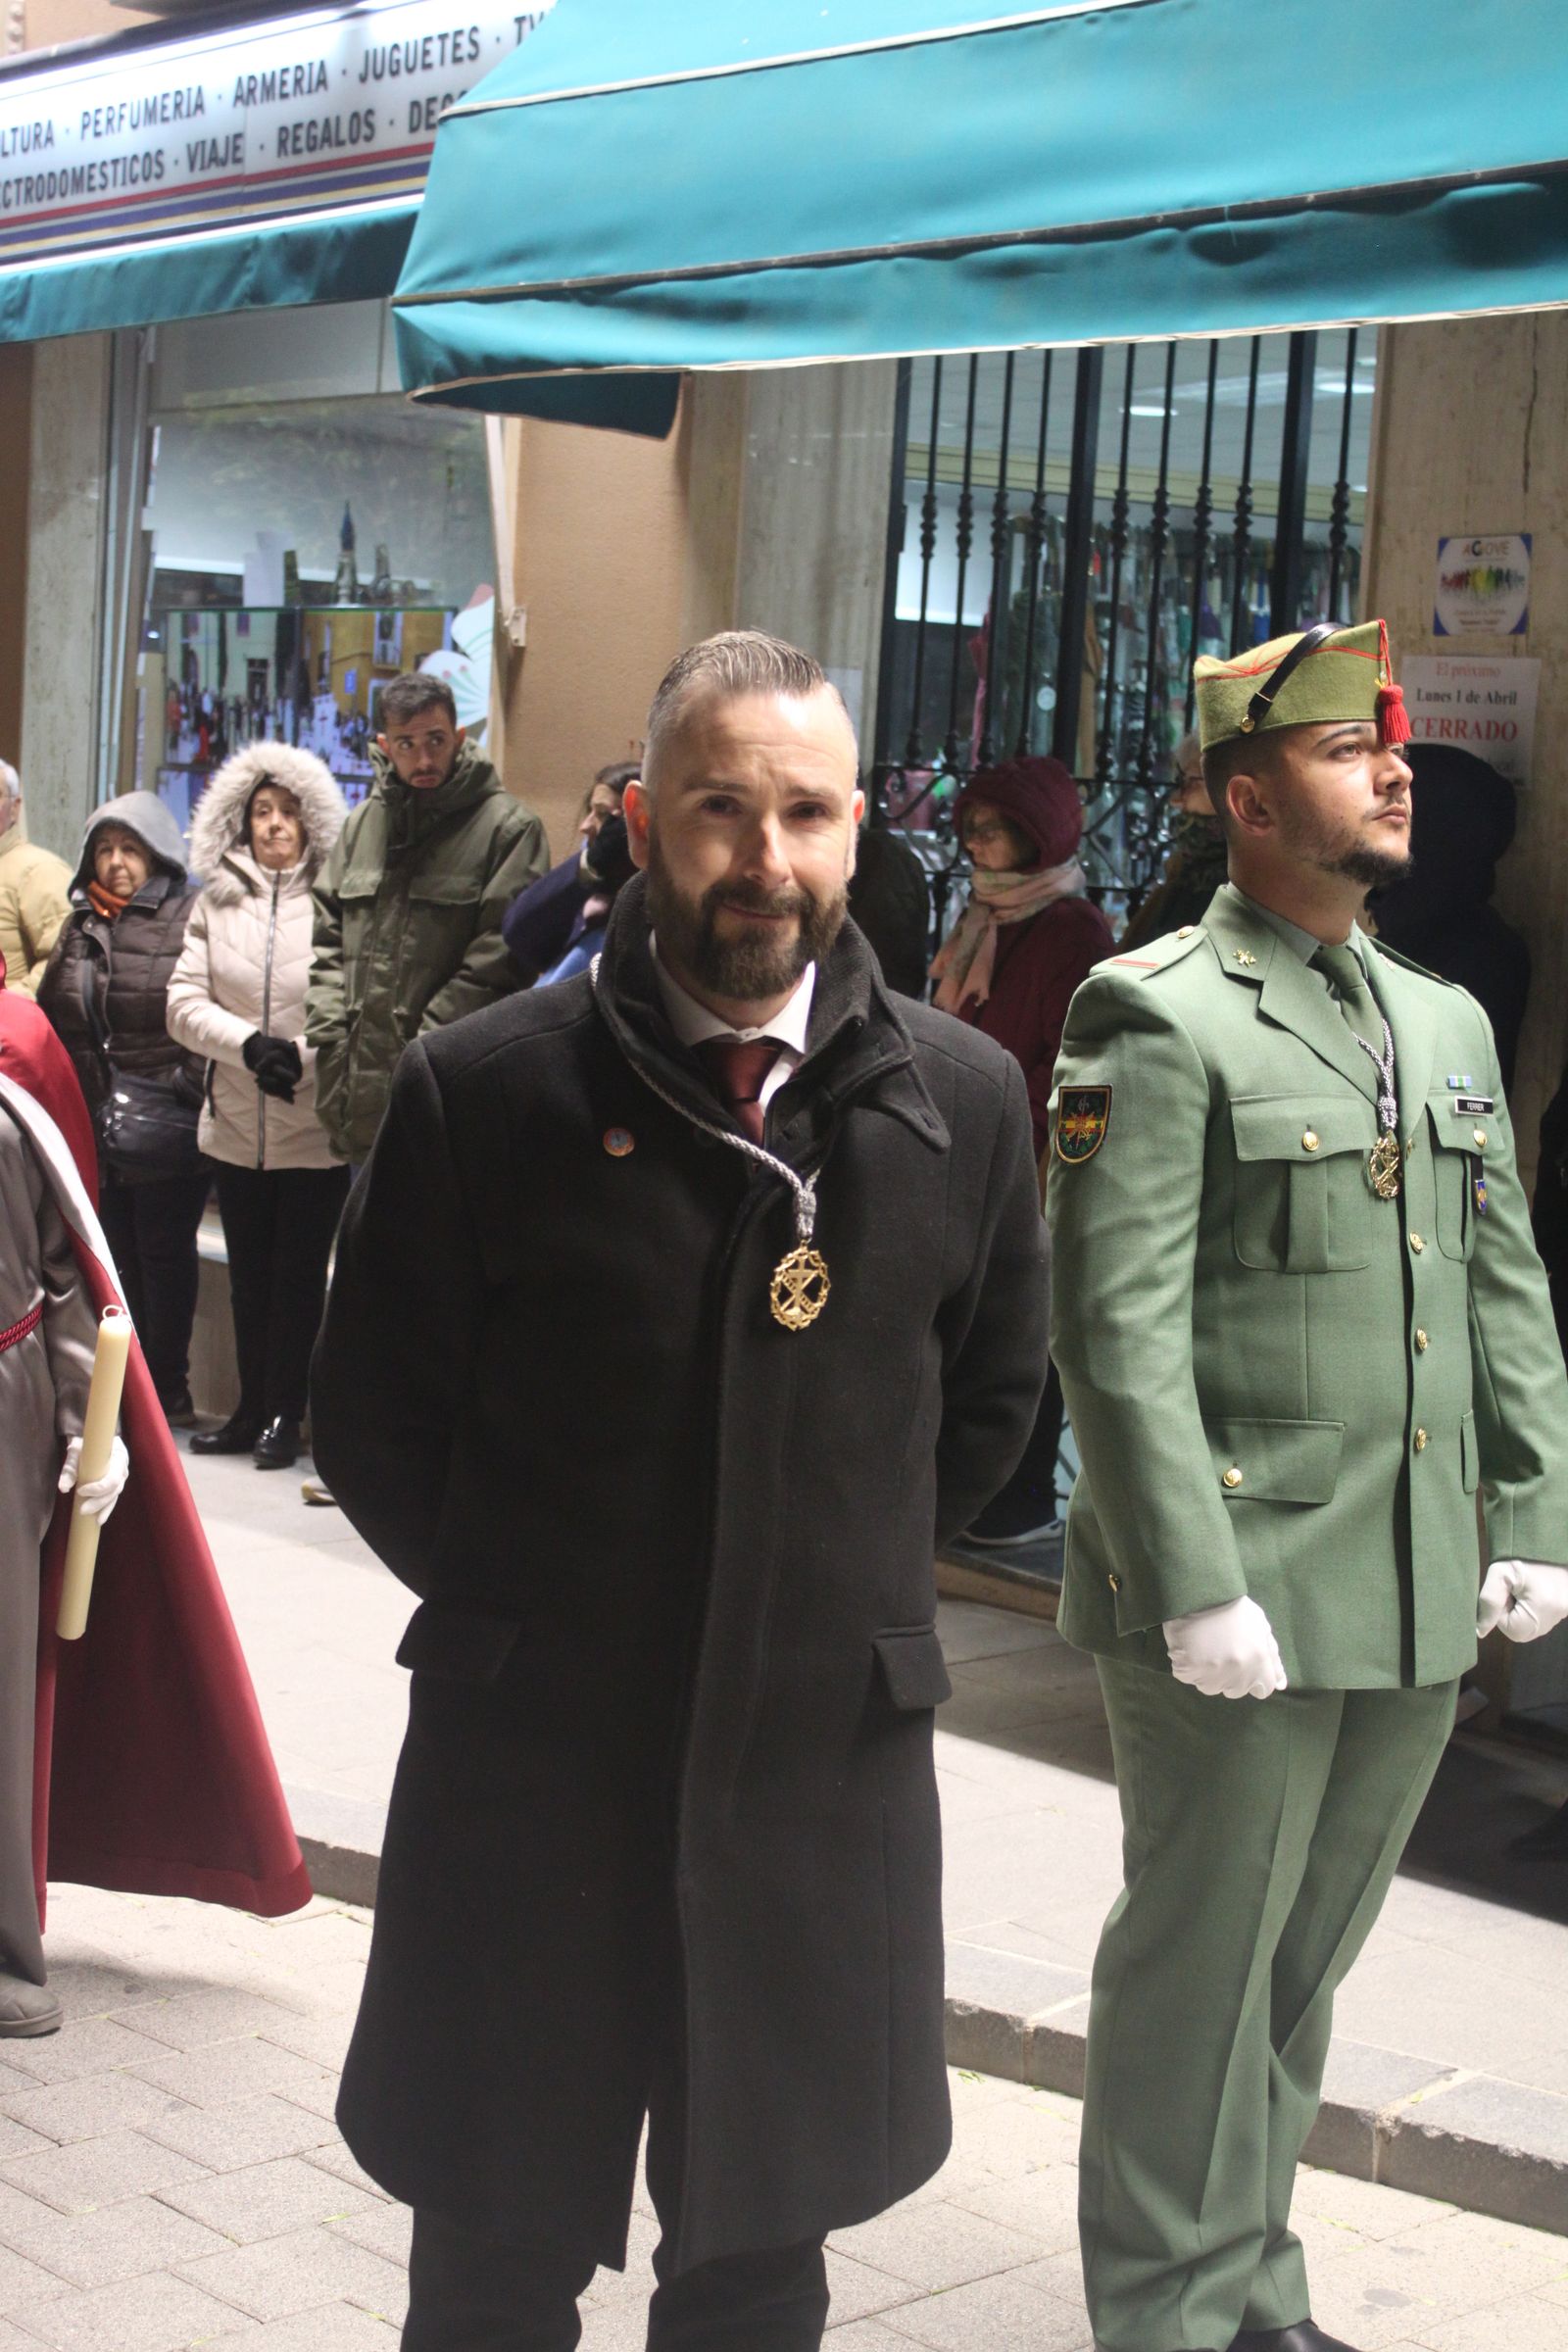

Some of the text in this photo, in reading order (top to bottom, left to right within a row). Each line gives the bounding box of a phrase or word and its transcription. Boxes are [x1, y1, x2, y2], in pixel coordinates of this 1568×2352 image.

[1, 119, 55, 157] LTURA
[80, 84, 205, 140] PERFUMERIA
[233, 60, 328, 108] ARMERIA
[359, 25, 480, 83] JUGUETES
[2, 90, 468, 209] CTRODOMESTICOS VIAJE REGALOS DE
[1410, 716, 1518, 742] CERRADO
[1416, 688, 1451, 703] Lunes
[1465, 690, 1481, 705] de
[1487, 690, 1517, 706] Abril
